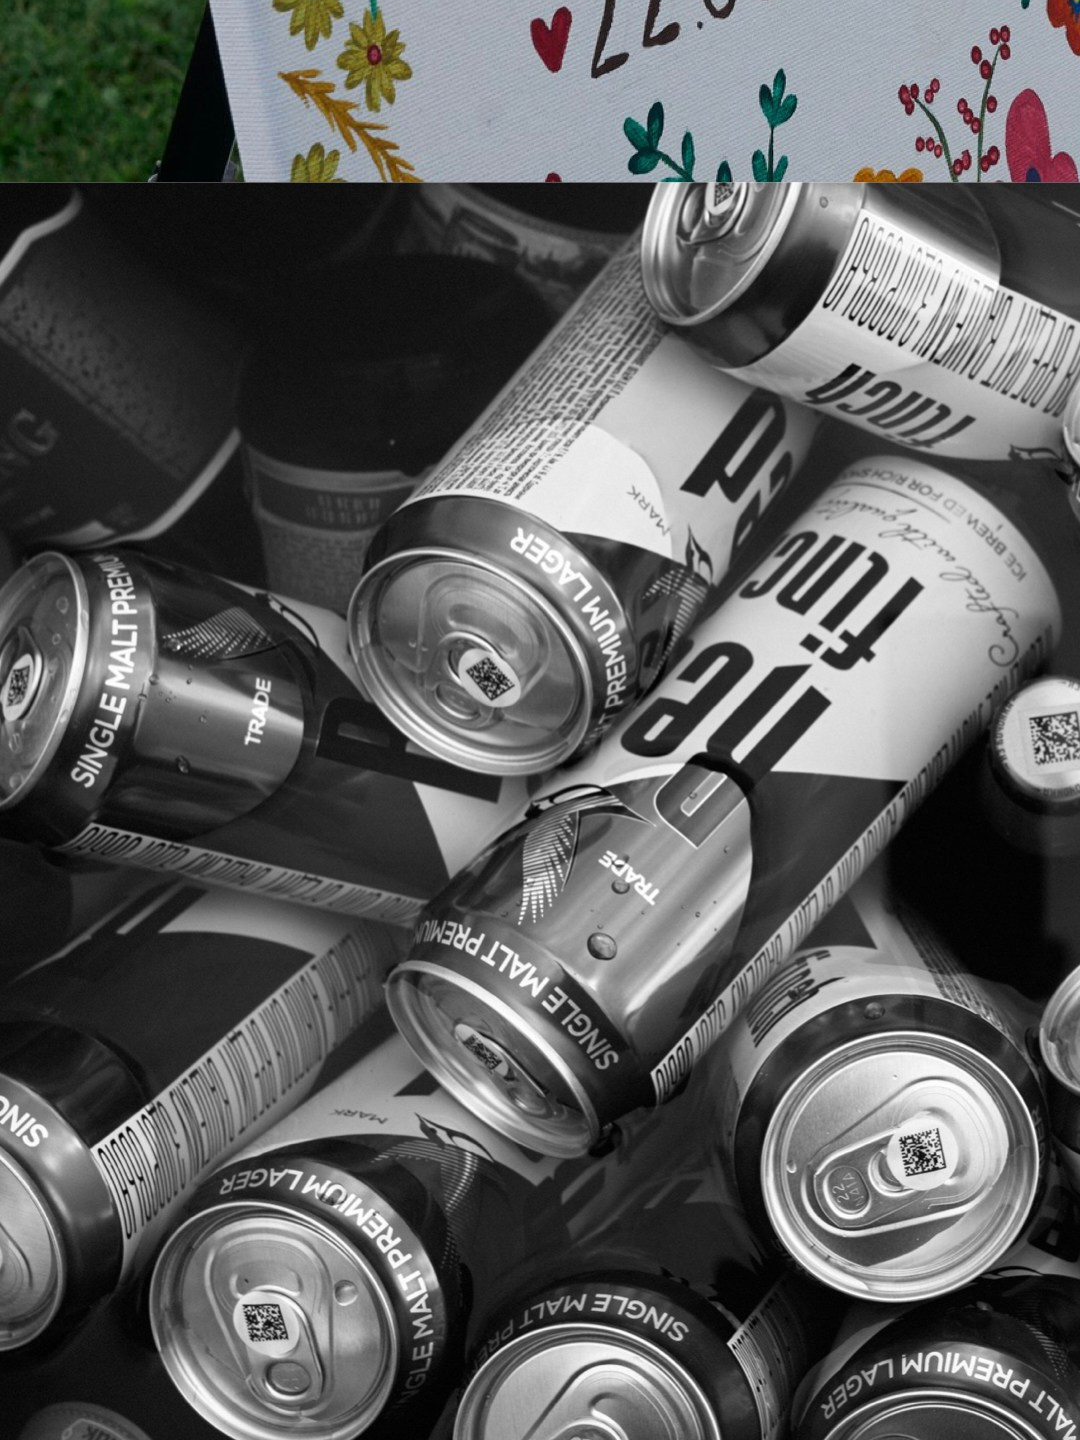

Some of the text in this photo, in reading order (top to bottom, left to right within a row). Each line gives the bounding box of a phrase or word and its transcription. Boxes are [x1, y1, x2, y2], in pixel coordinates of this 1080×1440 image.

[818, 215, 1080, 412] ВРЕДИТ ВАШЕМУ ЗДОРОВЬЮ
[626, 483, 673, 538] MARK
[907, 477, 944, 502] FOR
[507, 525, 629, 709] PREMIUM LAGER
[738, 529, 926, 672] finc
[70, 554, 139, 790] SINGLE MALT PREMIU
[243, 675, 273, 747] TRADE
[597, 849, 661, 906] TRADE
[480, 940, 549, 998] MALT
[541, 991, 619, 1072] SINGLE
[0, 1094, 49, 1148] SIN
[219, 1166, 300, 1196] LAGER
[302, 1172, 413, 1270] PREMIUM
[397, 1270, 435, 1340] MALT
[514, 1290, 690, 1343] SINGLE MALT
[821, 1358, 896, 1421] LAGER
[900, 1349, 1031, 1399] PREMIUM
